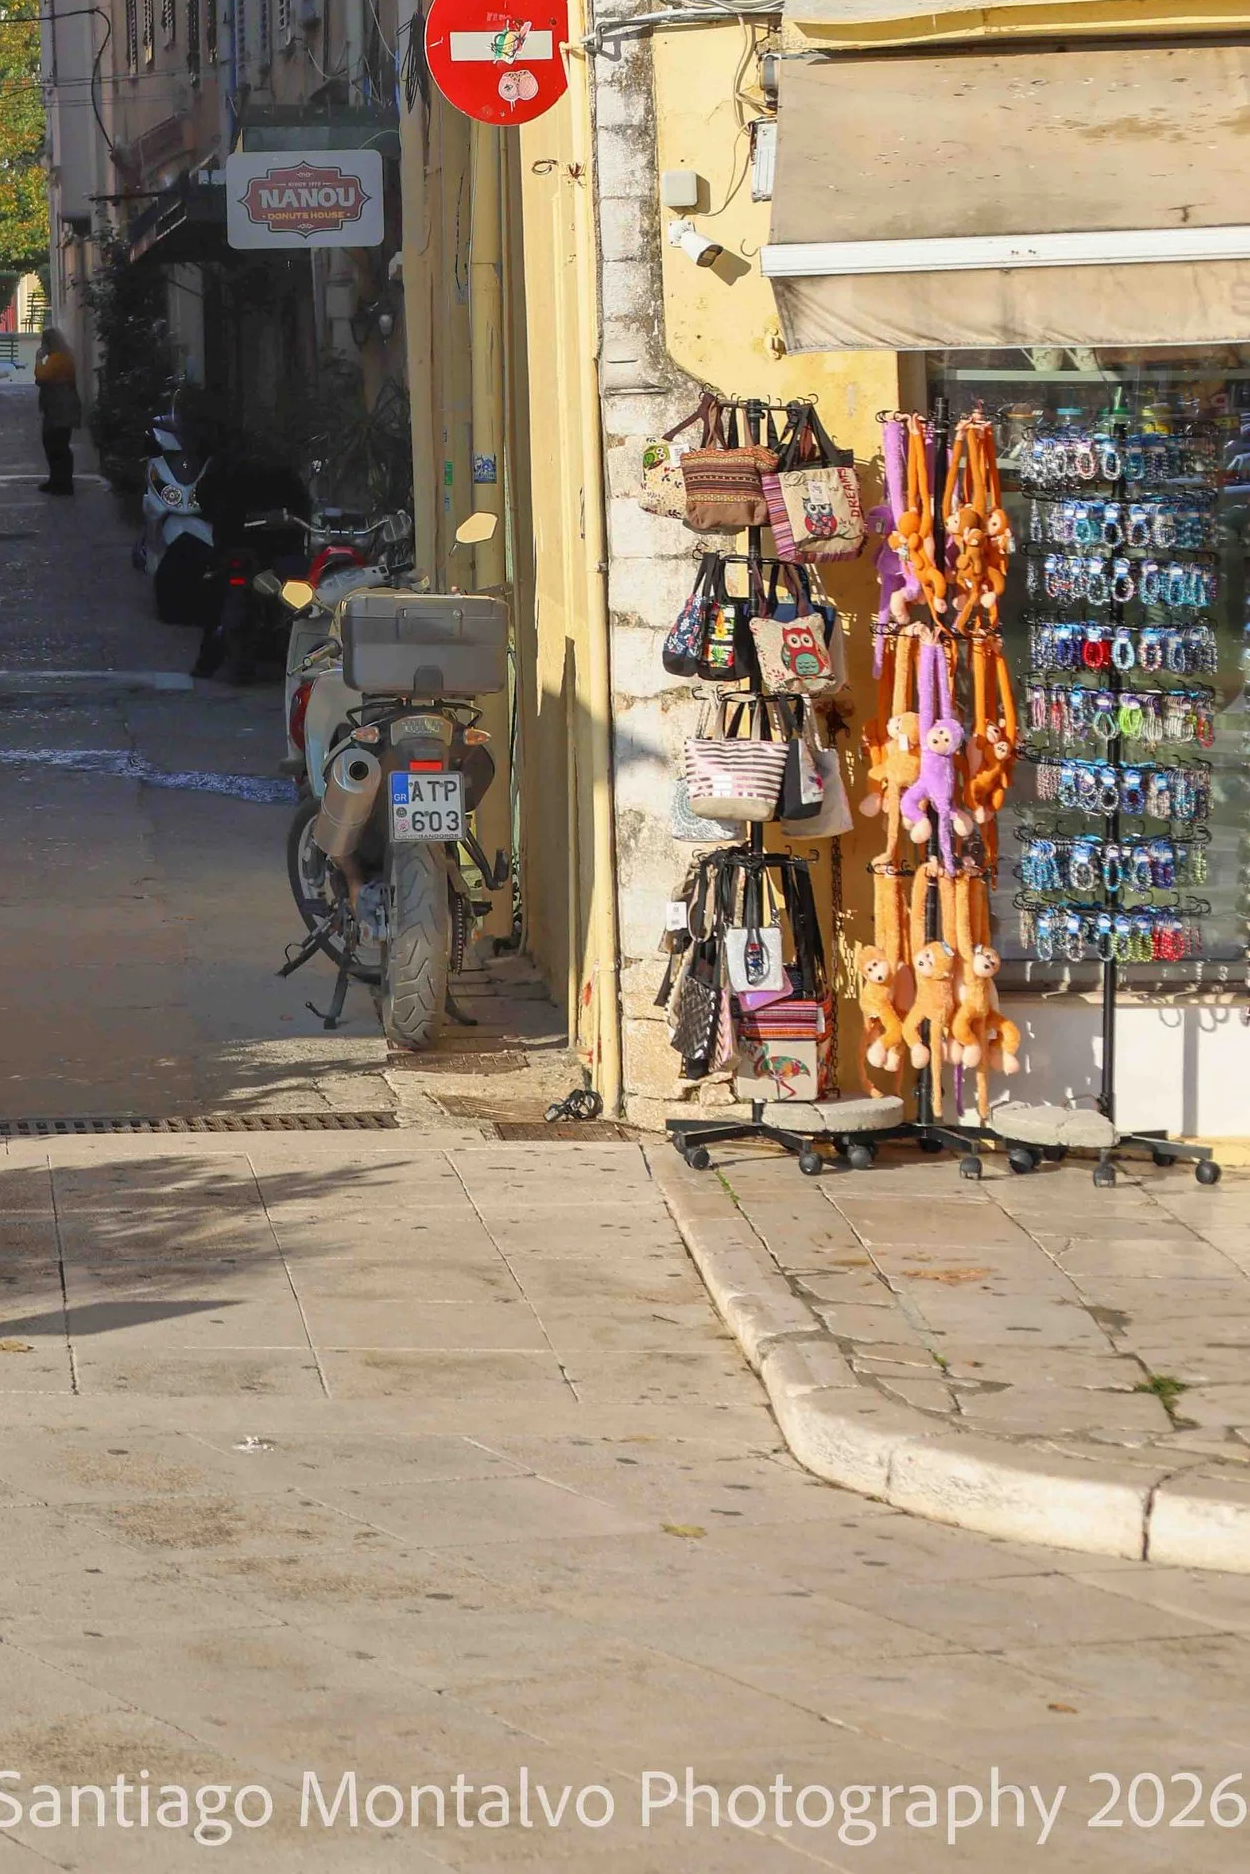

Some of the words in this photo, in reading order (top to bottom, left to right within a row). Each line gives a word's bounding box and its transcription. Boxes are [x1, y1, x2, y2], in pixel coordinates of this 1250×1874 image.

[259, 188, 356, 209] NANOU
[267, 212, 309, 220] DONUTS
[310, 211, 346, 219] HOUSE
[836, 468, 861, 517] DREAMS
[393, 793, 407, 802] GR
[411, 780, 457, 802] ATP
[411, 810, 459, 832] 603
